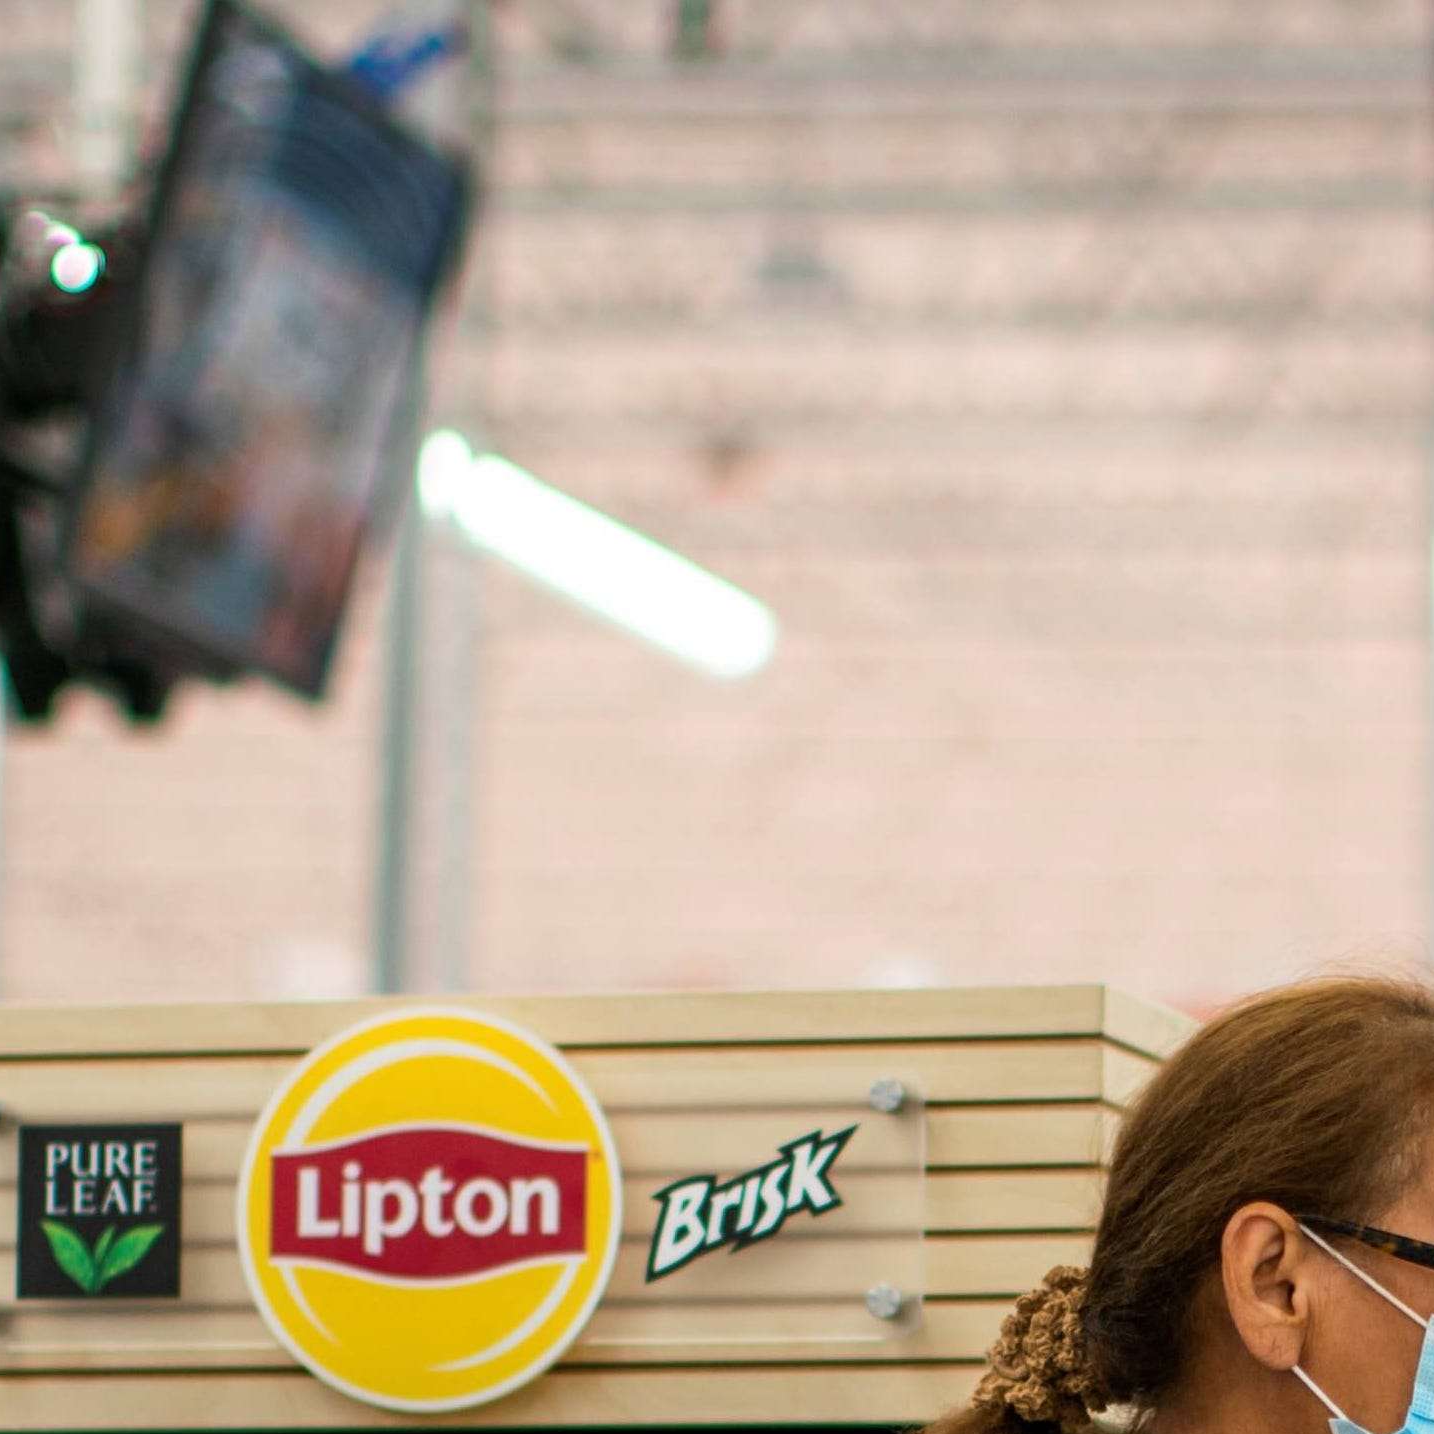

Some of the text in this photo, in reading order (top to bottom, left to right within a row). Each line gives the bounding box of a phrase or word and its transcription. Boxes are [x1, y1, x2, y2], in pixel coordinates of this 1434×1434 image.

[45, 1141, 158, 1178] PURE
[44, 1181, 158, 1217] LEAF
[295, 1165, 561, 1257] Lipton
[651, 1128, 854, 1280] Brisk
